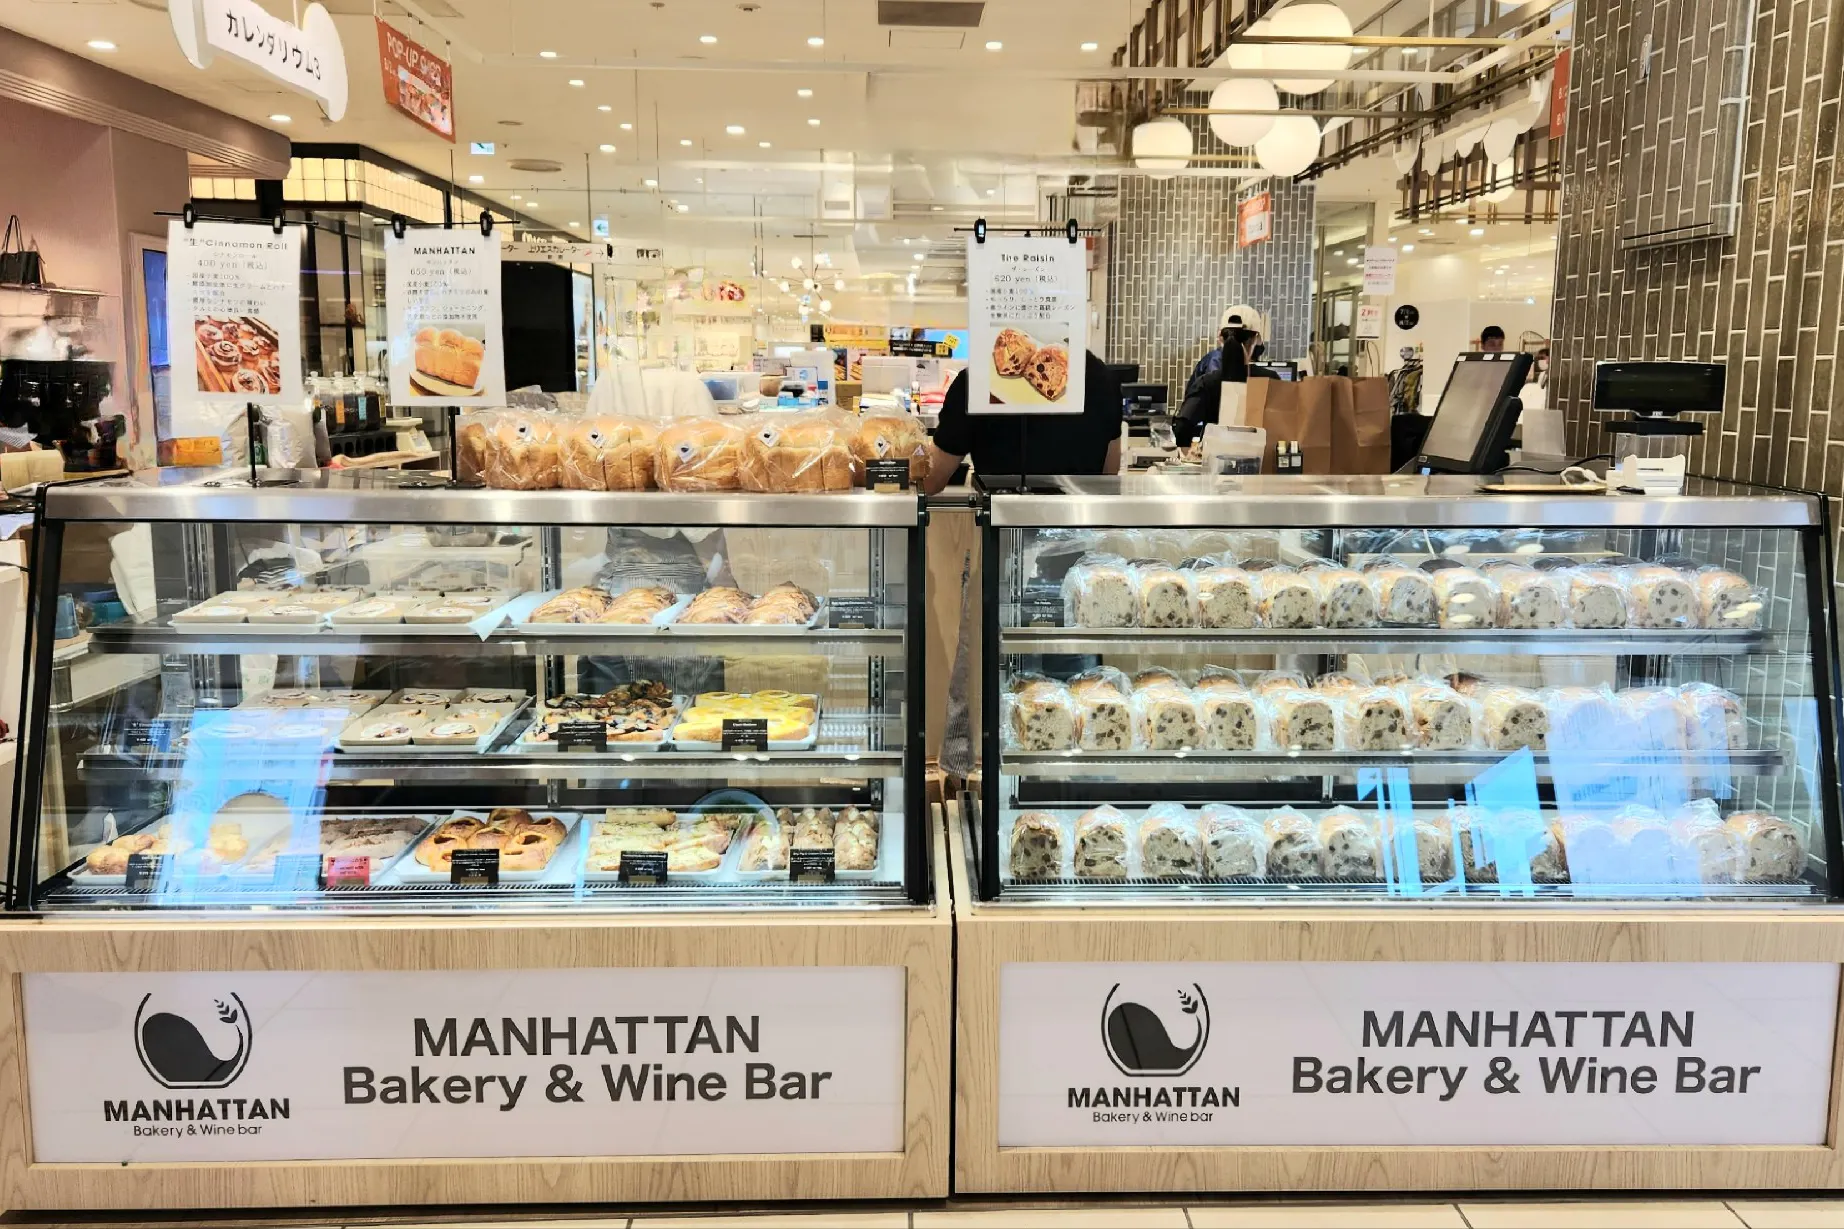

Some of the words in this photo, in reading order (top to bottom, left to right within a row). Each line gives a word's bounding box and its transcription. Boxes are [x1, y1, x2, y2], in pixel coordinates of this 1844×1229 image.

[225, 8, 321, 80] カレンダリウム3
[386, 31, 419, 68] POP-UP
[266, 242, 288, 250] Roll
[413, 247, 476, 255] MANHATTAN
[197, 259, 216, 267] 400
[220, 261, 238, 270] yen
[1001, 253, 1019, 262] The
[1023, 253, 1055, 262] Raisin
[994, 274, 1012, 282] 620
[1014, 276, 1031, 284] yen
[414, 1016, 760, 1056] MANHATTAN
[1363, 1011, 1695, 1047] MANHATTAN
[344, 1066, 528, 1112] Bakery
[546, 1064, 585, 1104] &
[601, 1064, 728, 1102] Wine
[746, 1063, 833, 1101] Bar
[1293, 1057, 1469, 1102] Bakery
[1484, 1057, 1521, 1095] &
[1539, 1057, 1658, 1095] Wine
[1676, 1057, 1762, 1094] Bar
[1068, 1087, 1240, 1108] MANHATTAN
[104, 1098, 290, 1122] MANHATTAN
[1092, 1112, 1140, 1125] Bakery
[1143, 1112, 1153, 1123] &
[133, 1124, 184, 1139] Bakery
[187, 1124, 198, 1137] &
